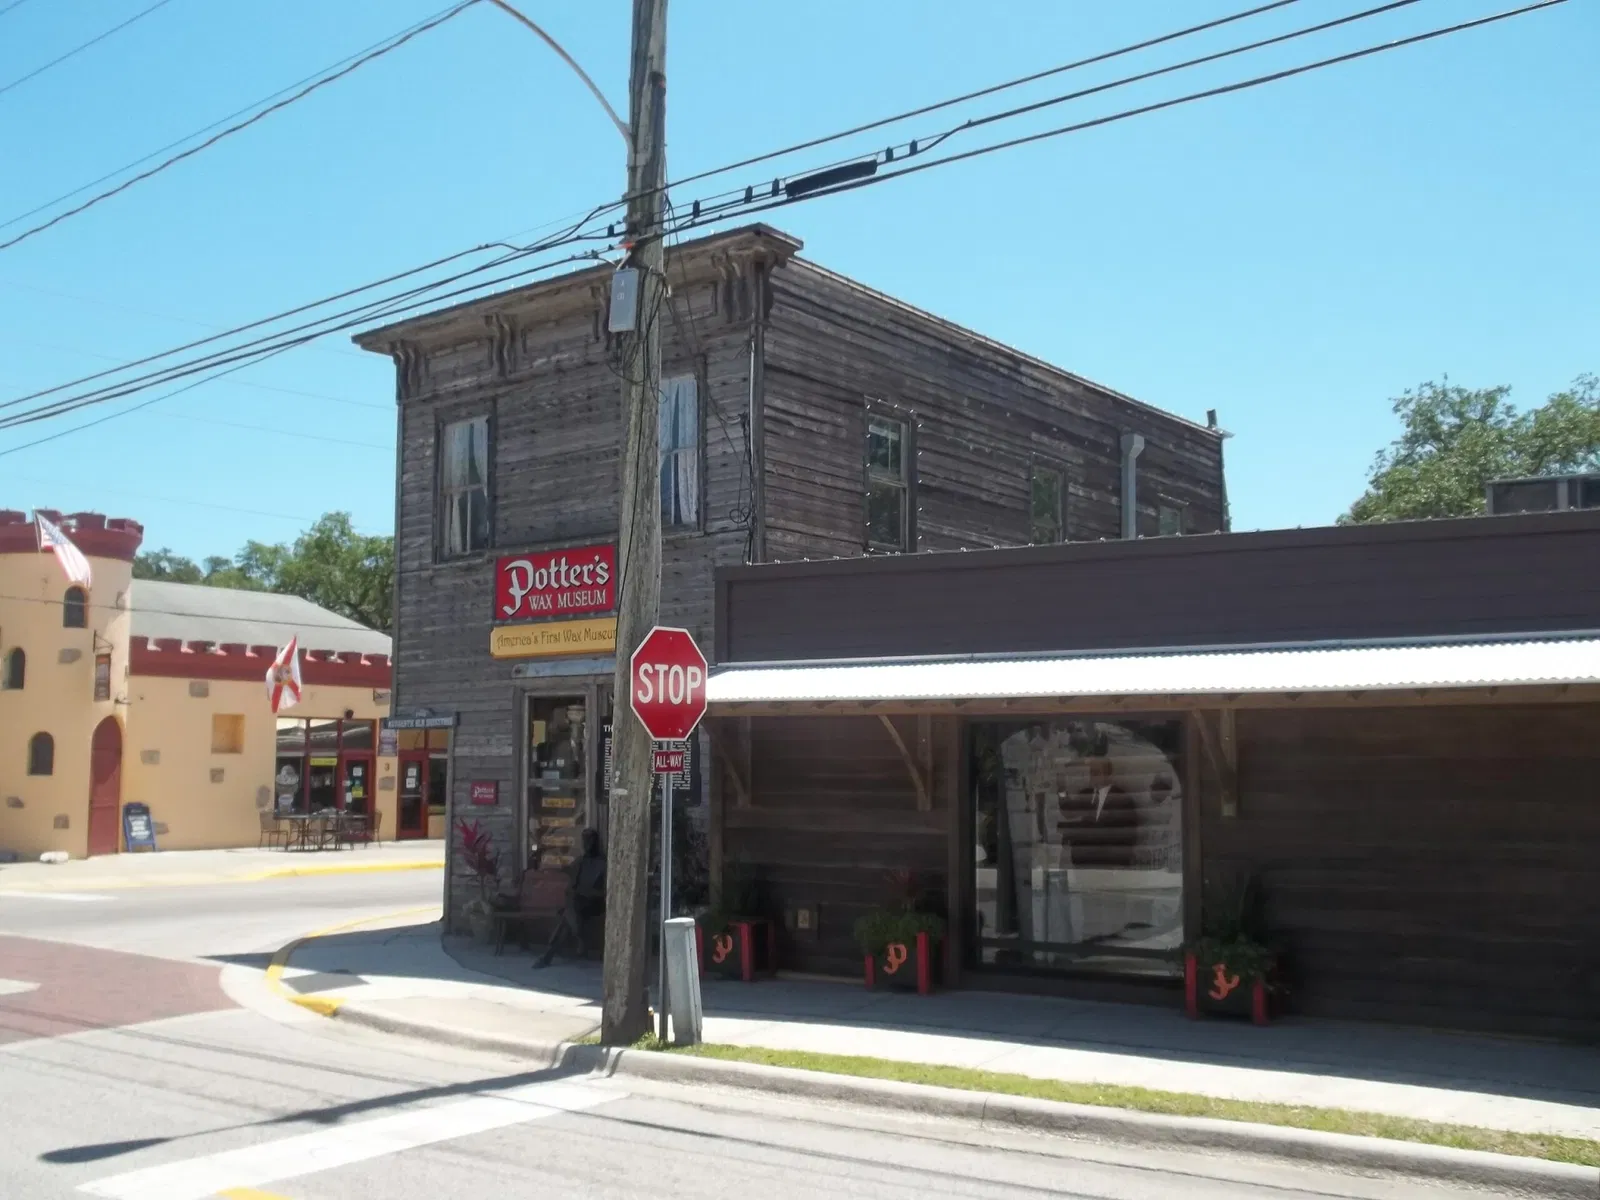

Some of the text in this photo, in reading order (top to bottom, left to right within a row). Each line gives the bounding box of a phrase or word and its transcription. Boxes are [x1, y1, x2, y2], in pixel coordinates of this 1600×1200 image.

[502, 554, 610, 616] Potter's
[528, 588, 606, 611] WAX MUSEUM
[497, 631, 539, 649] America's
[541, 630, 561, 645] First
[563, 628, 582, 643] Wax
[637, 662, 702, 705] STOP
[656, 754, 683, 768] ALL-WAY
